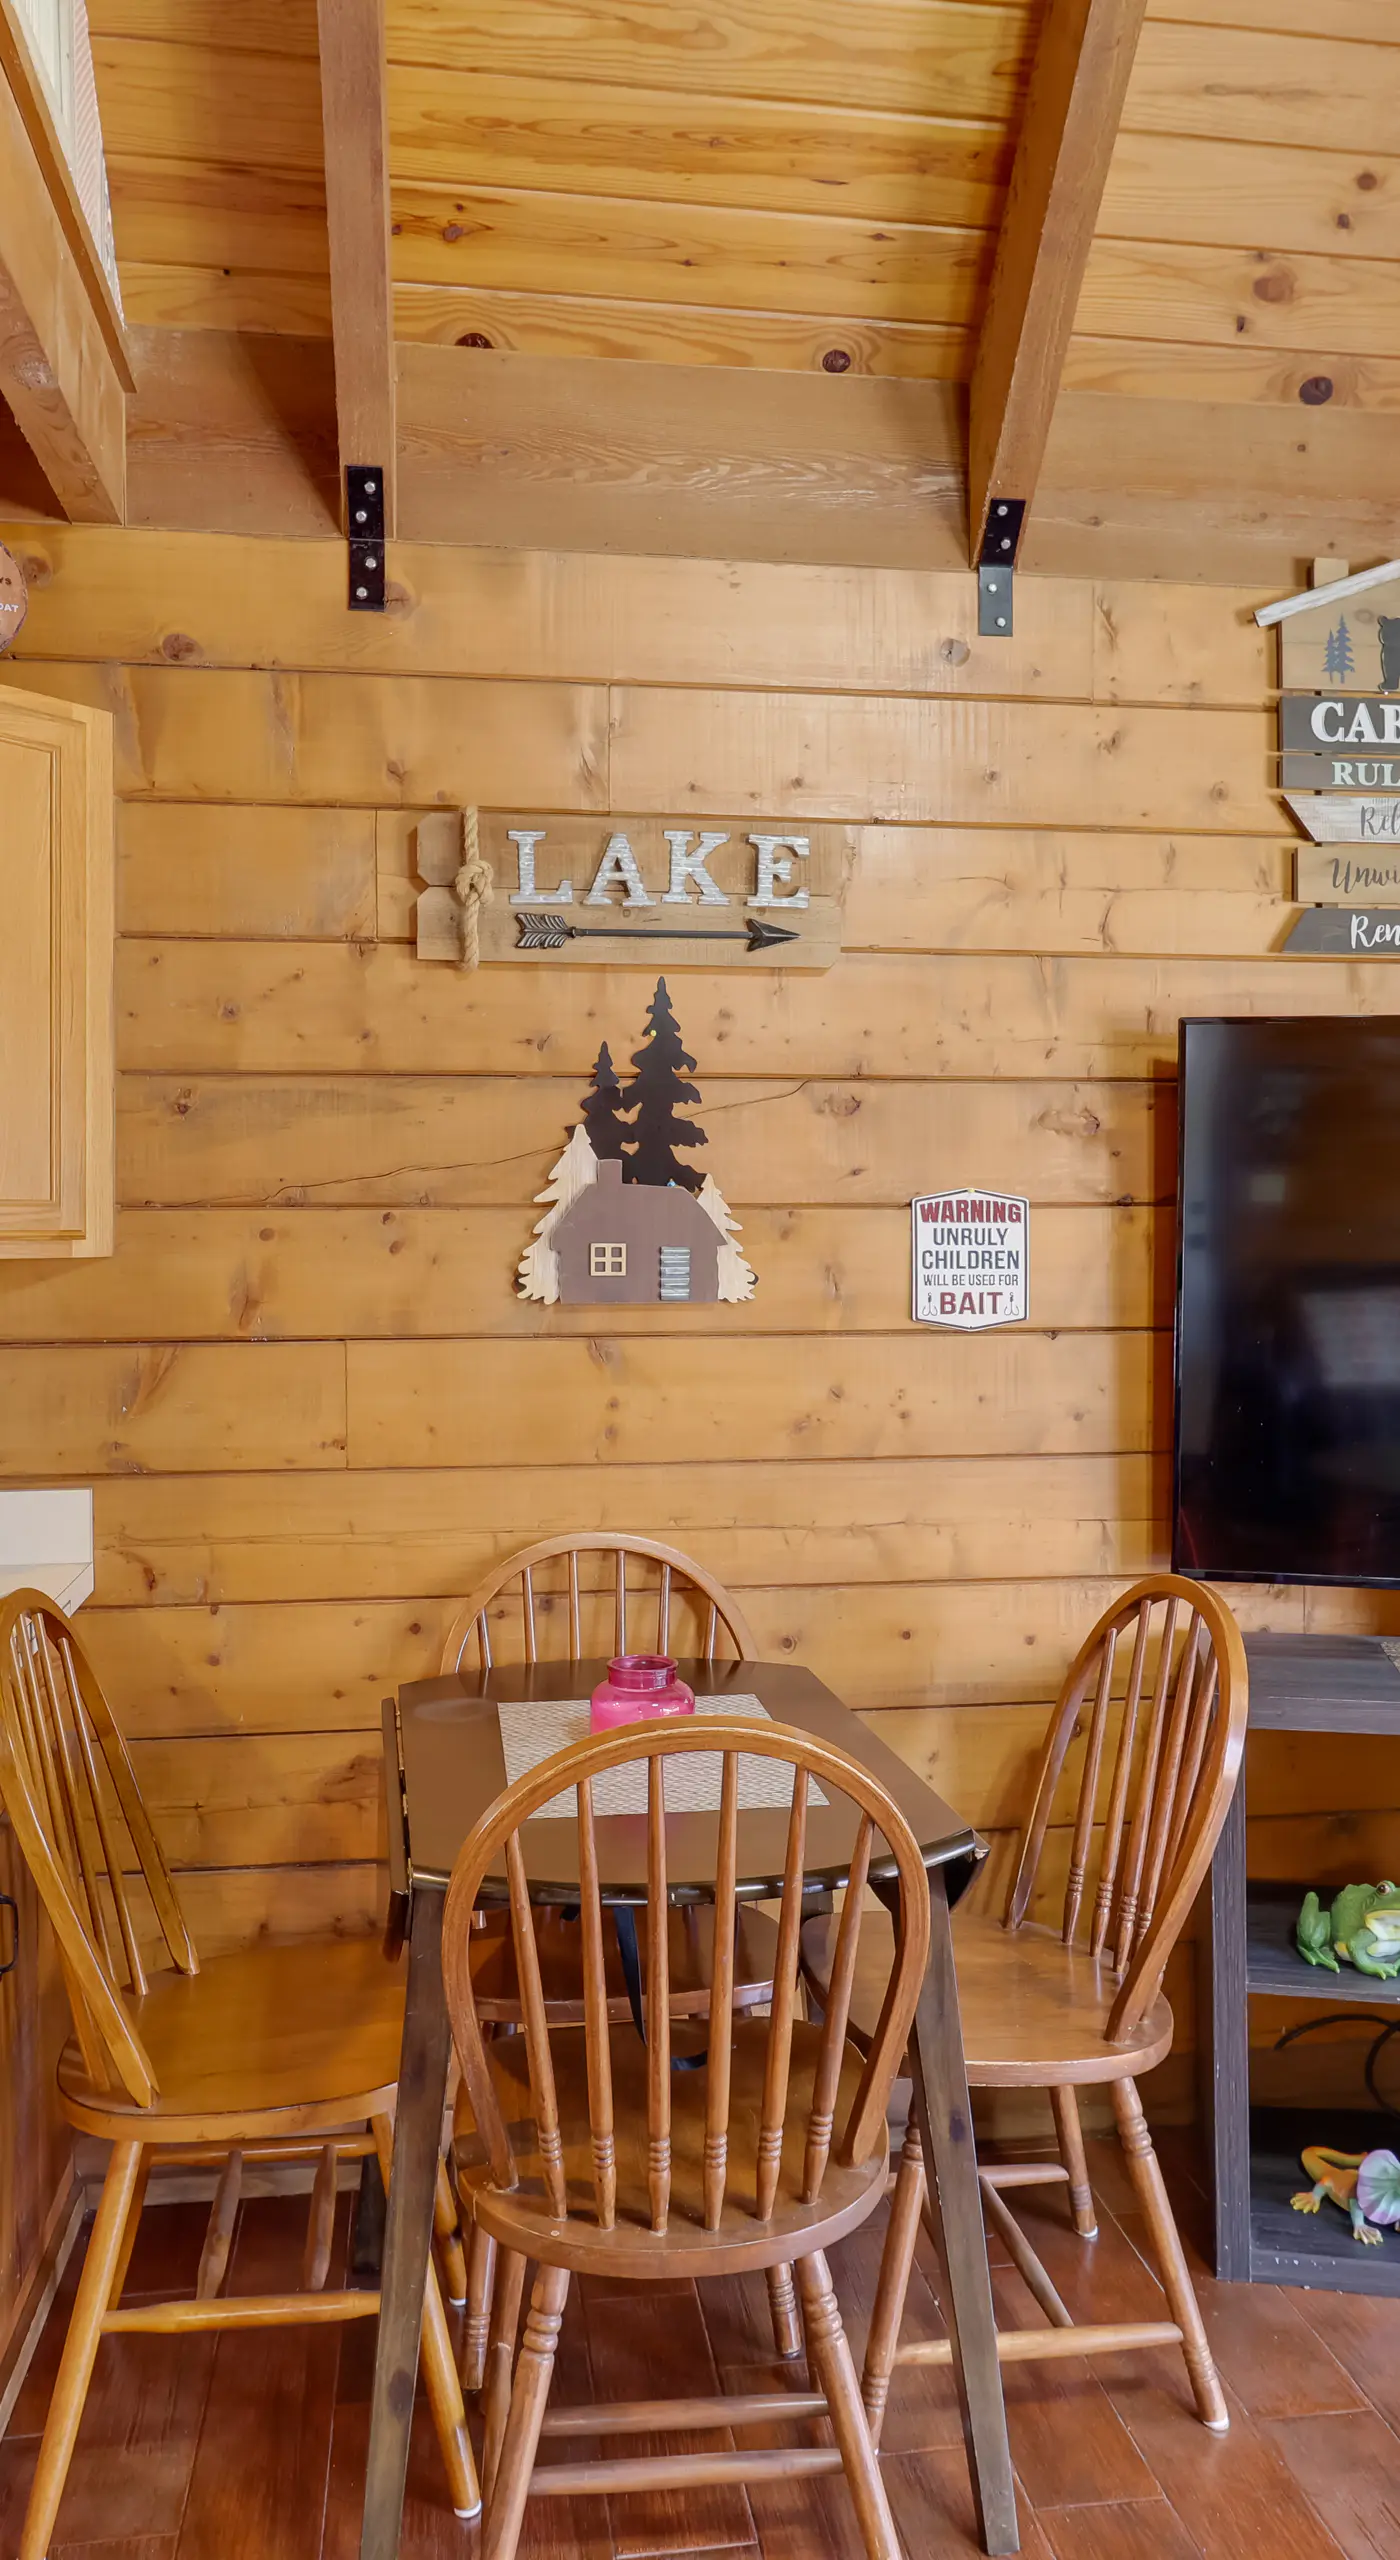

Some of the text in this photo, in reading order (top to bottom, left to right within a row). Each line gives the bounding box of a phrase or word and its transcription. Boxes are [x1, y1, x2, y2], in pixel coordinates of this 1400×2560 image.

[1311, 702, 1400, 743] CAB
[1331, 761, 1400, 786] RUL
[507, 829, 810, 909] LAKE
[919, 1199, 1022, 1224] WARNING
[933, 1227, 1009, 1246] UNRULY
[922, 1250, 1020, 1270] CHILDREN
[923, 1274, 1019, 1286] WILL BE USED FOR
[940, 1292, 1003, 1315] BAIT
